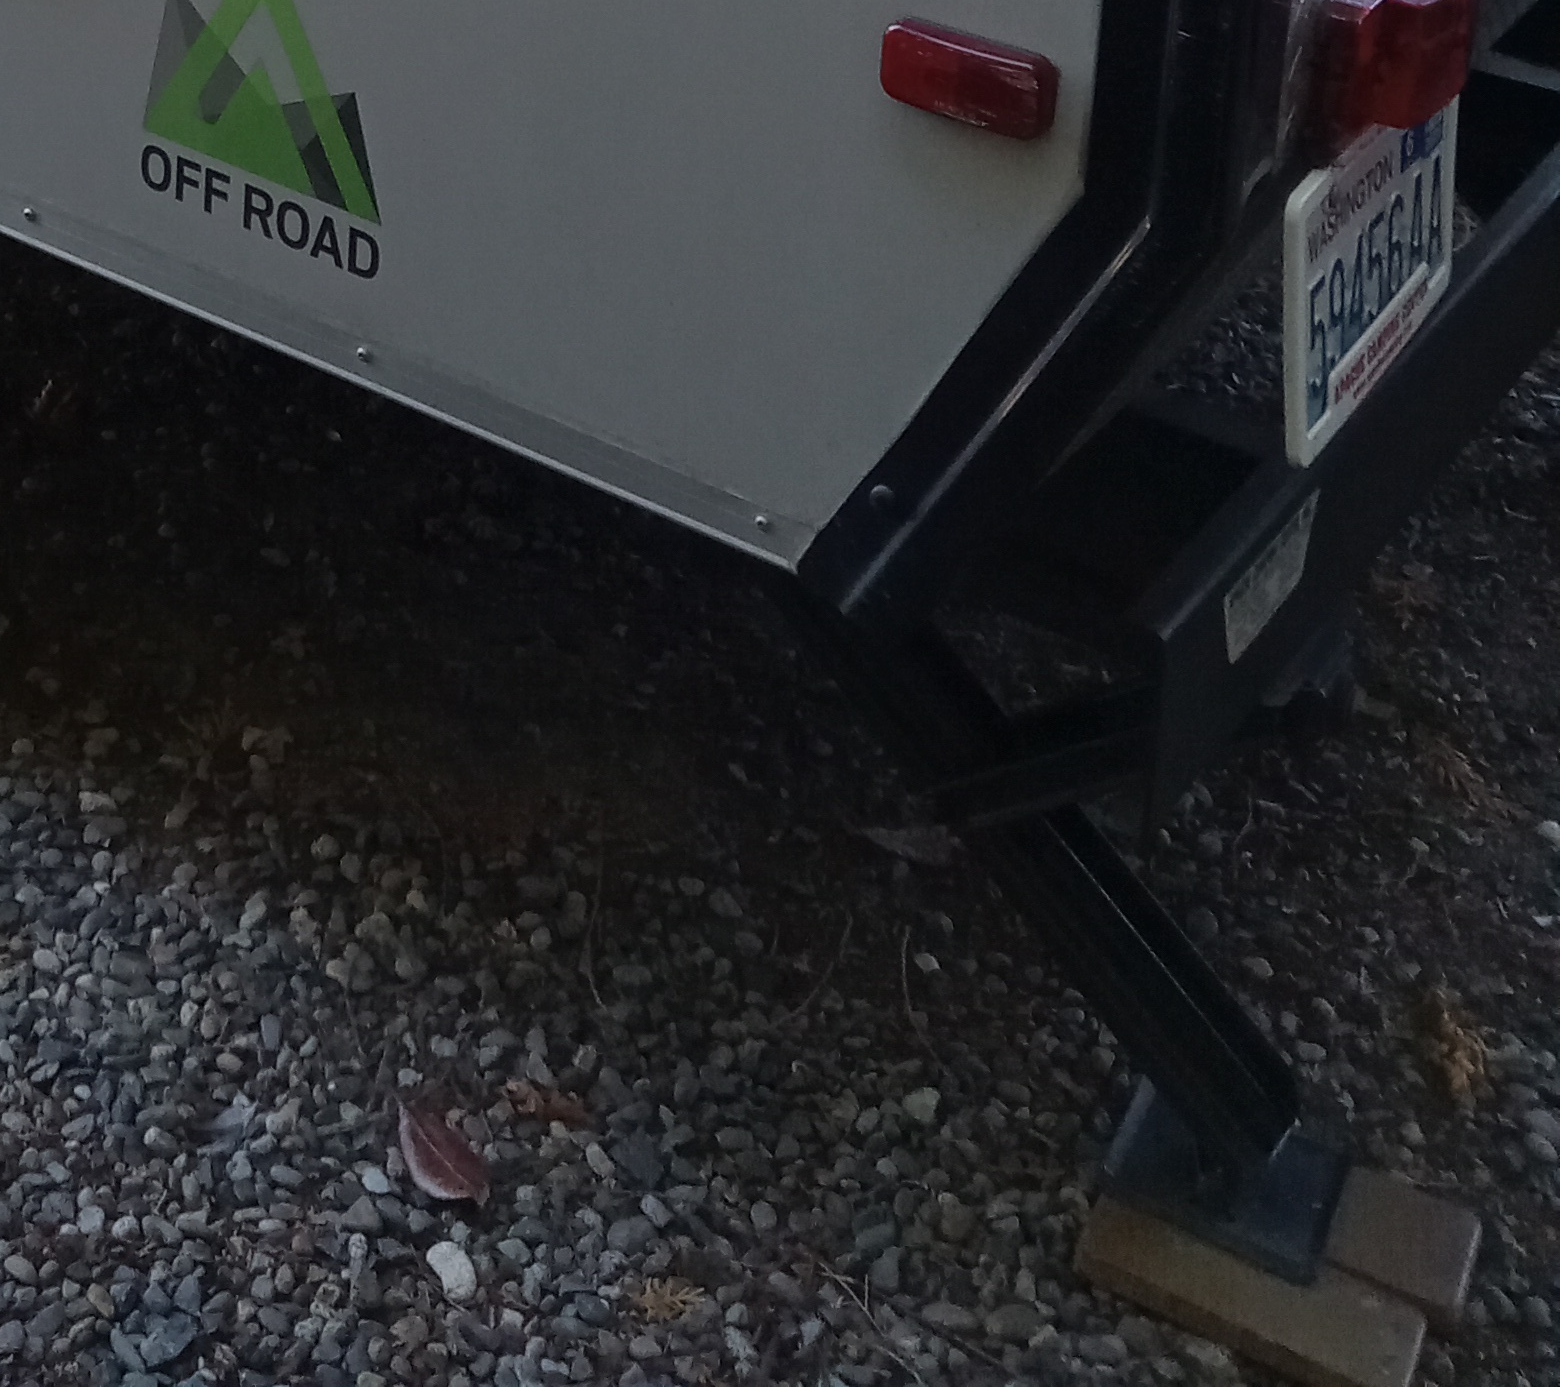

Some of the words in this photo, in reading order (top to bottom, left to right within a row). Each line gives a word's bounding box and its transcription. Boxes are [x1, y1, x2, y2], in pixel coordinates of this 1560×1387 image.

[141, 144, 231, 214] OFF
[243, 183, 381, 279] ROAD
[1307, 151, 1395, 263] WASHINGTON
[1306, 153, 1444, 413] 59456AA
